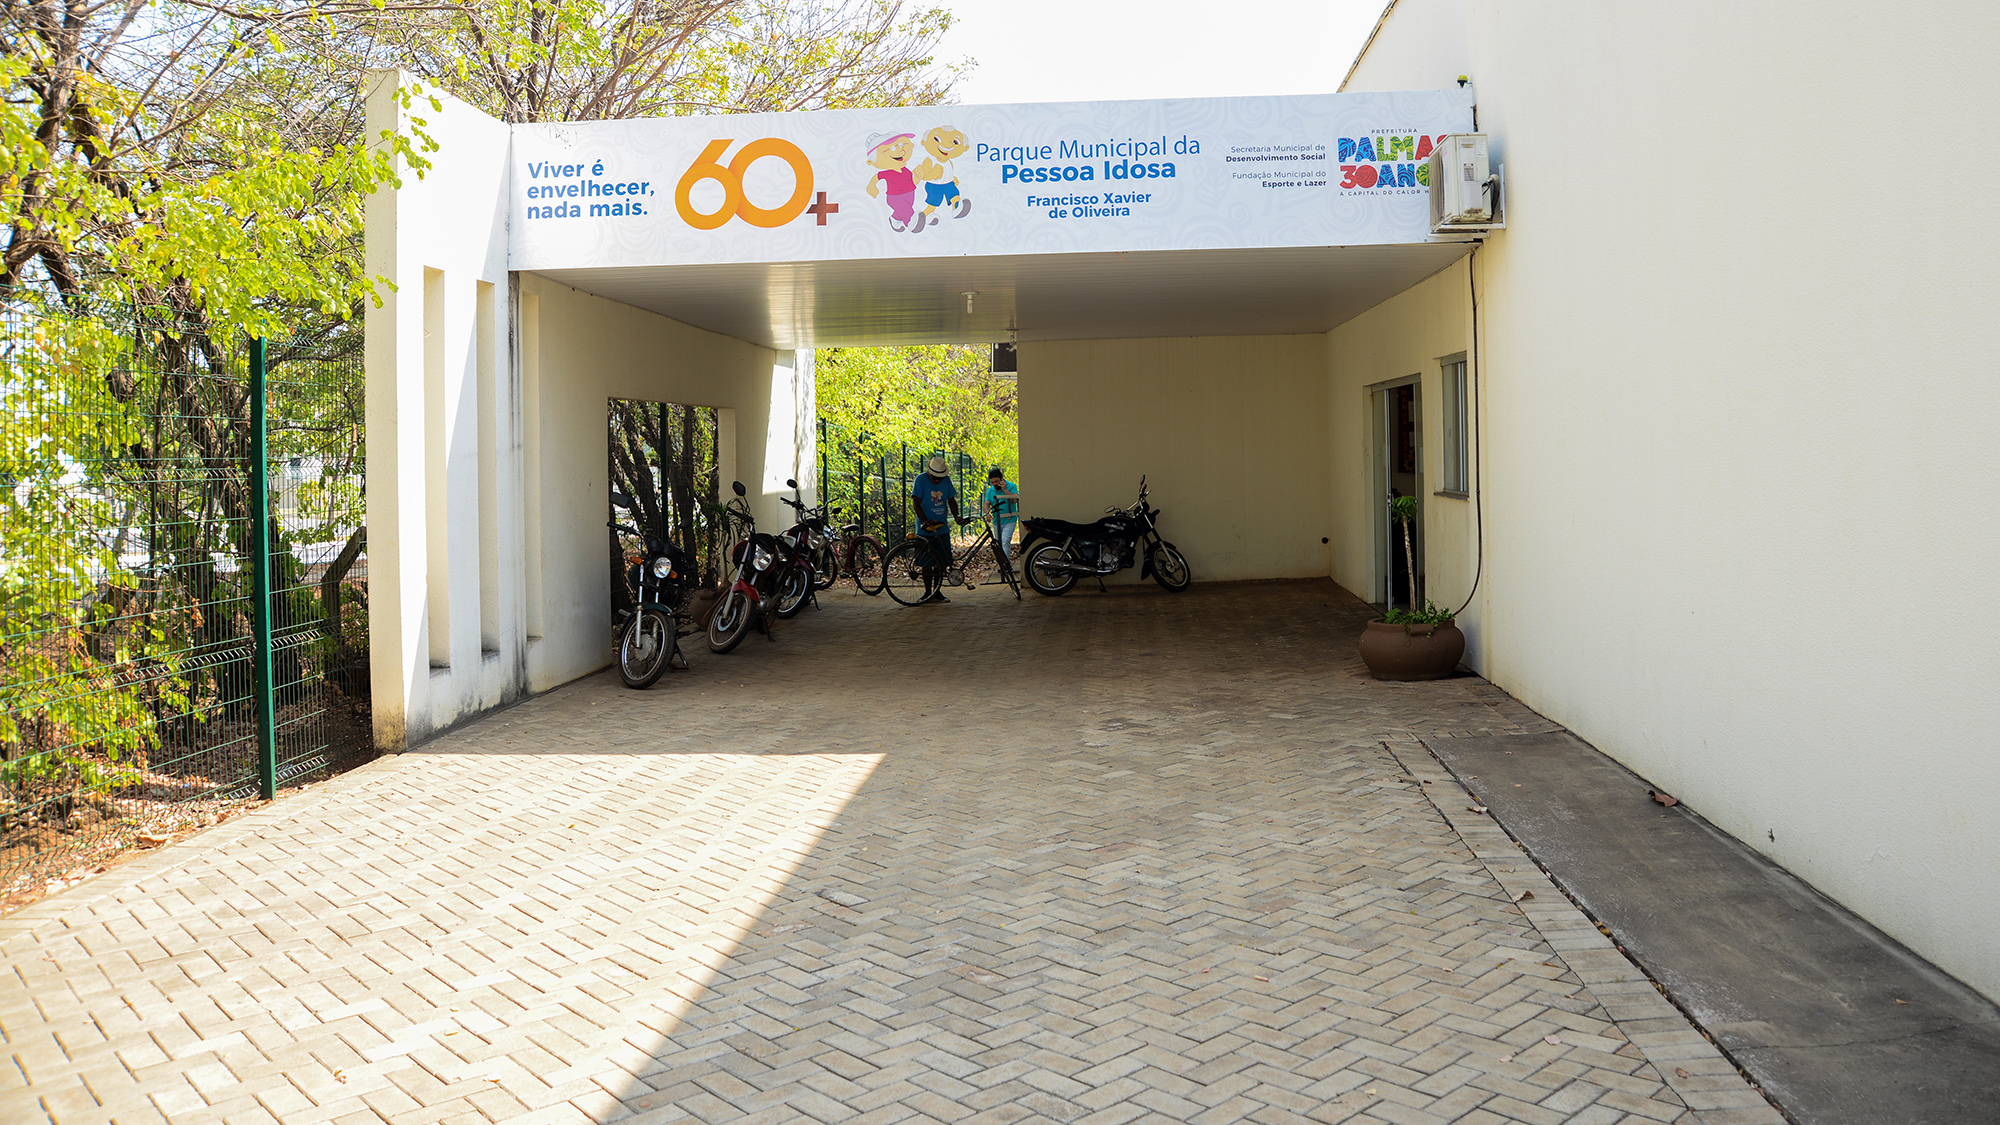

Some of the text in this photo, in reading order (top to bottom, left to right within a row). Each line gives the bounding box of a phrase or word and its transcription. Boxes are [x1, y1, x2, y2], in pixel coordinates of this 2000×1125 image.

[976, 135, 1201, 165] Parque Municipal da
[1230, 143, 1326, 154] Secretaria Municipal de
[1225, 152, 1326, 163] Desenvolvimento Social
[527, 158, 604, 178] Viver é
[1002, 158, 1176, 184] Pessoa Idosa
[1232, 169, 1327, 180] Fundação Municipal do
[527, 179, 655, 199] envelhecer,
[1261, 180, 1295, 189] Esporte
[1304, 179, 1327, 187] Lazer
[1027, 190, 1152, 207] Francisco Xavier
[527, 197, 648, 220] nada mais.
[1048, 205, 1131, 219] de Oliveira
